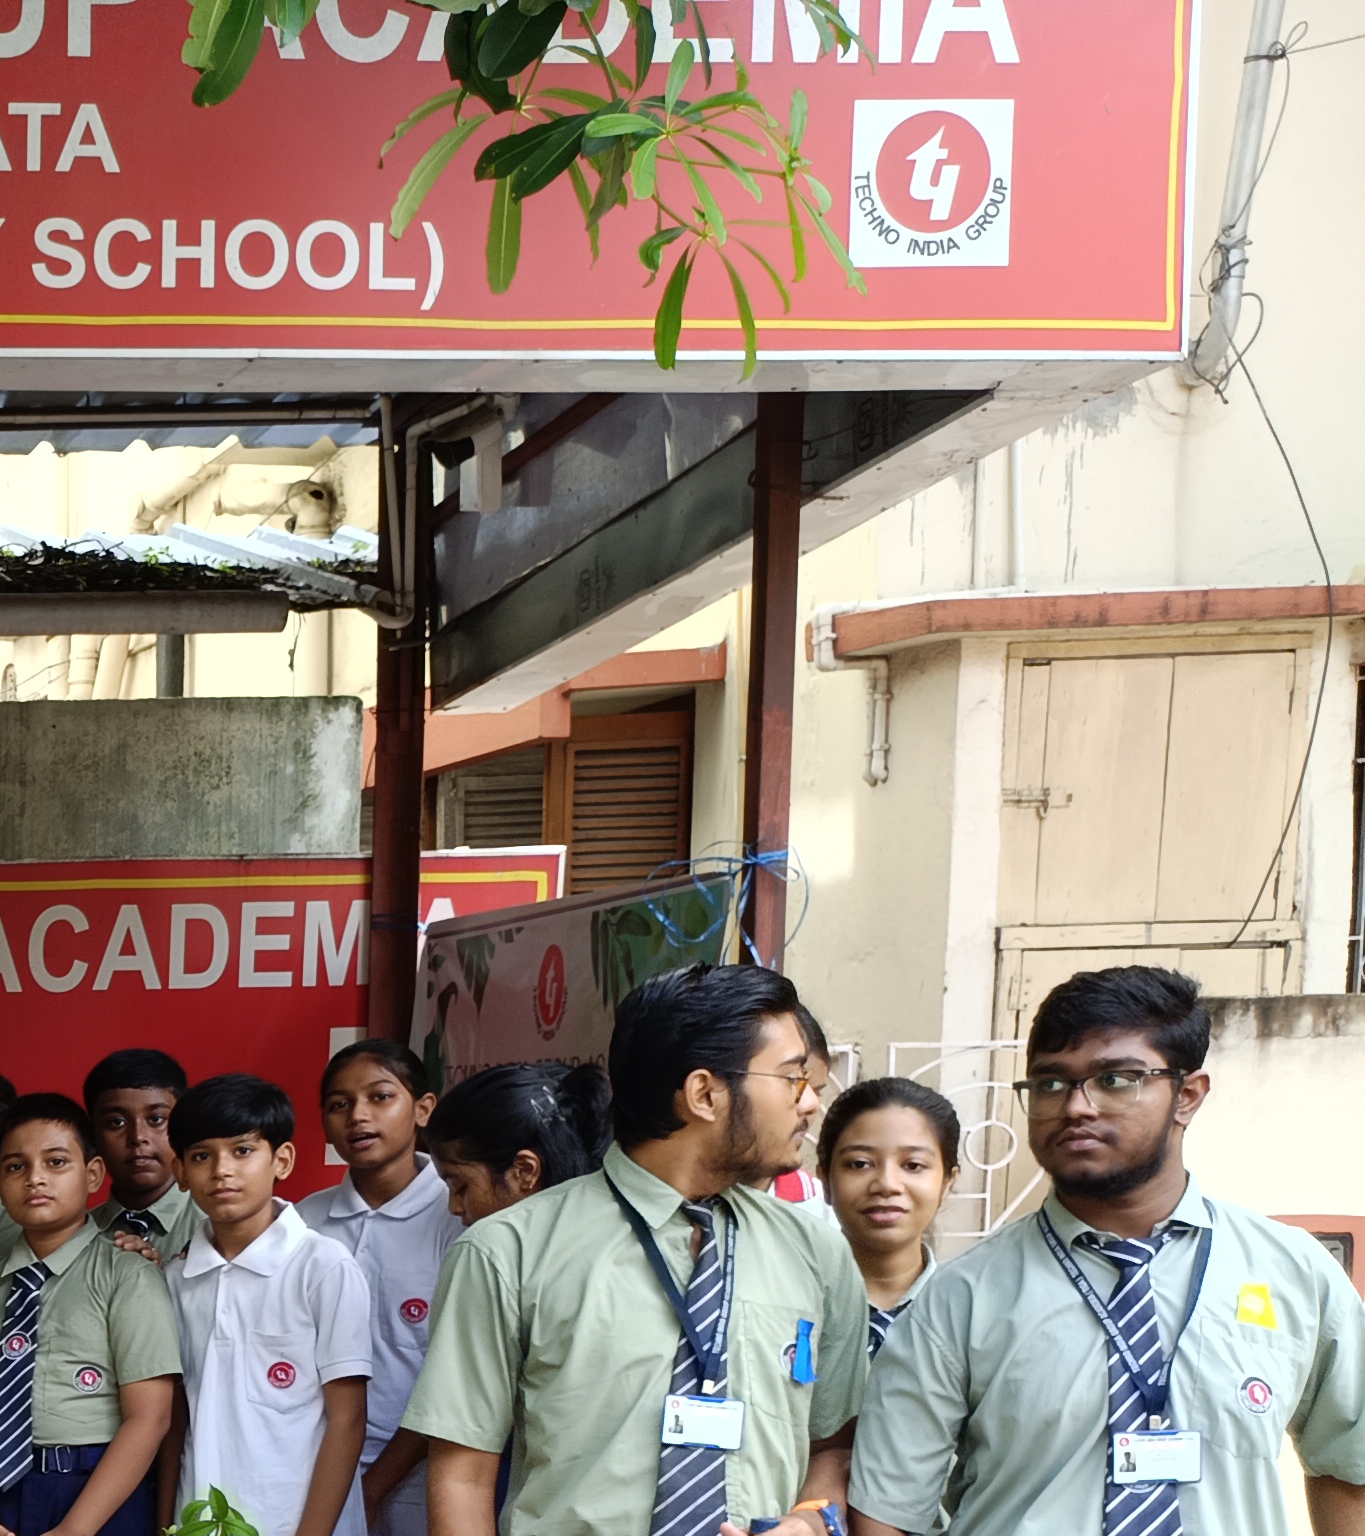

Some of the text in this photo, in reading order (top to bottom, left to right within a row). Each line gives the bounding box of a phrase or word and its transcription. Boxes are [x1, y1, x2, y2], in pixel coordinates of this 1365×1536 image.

[854, 171, 1008, 257] TECHNO INDIA GROUP
[31, 216, 445, 311] SCHOOL)
